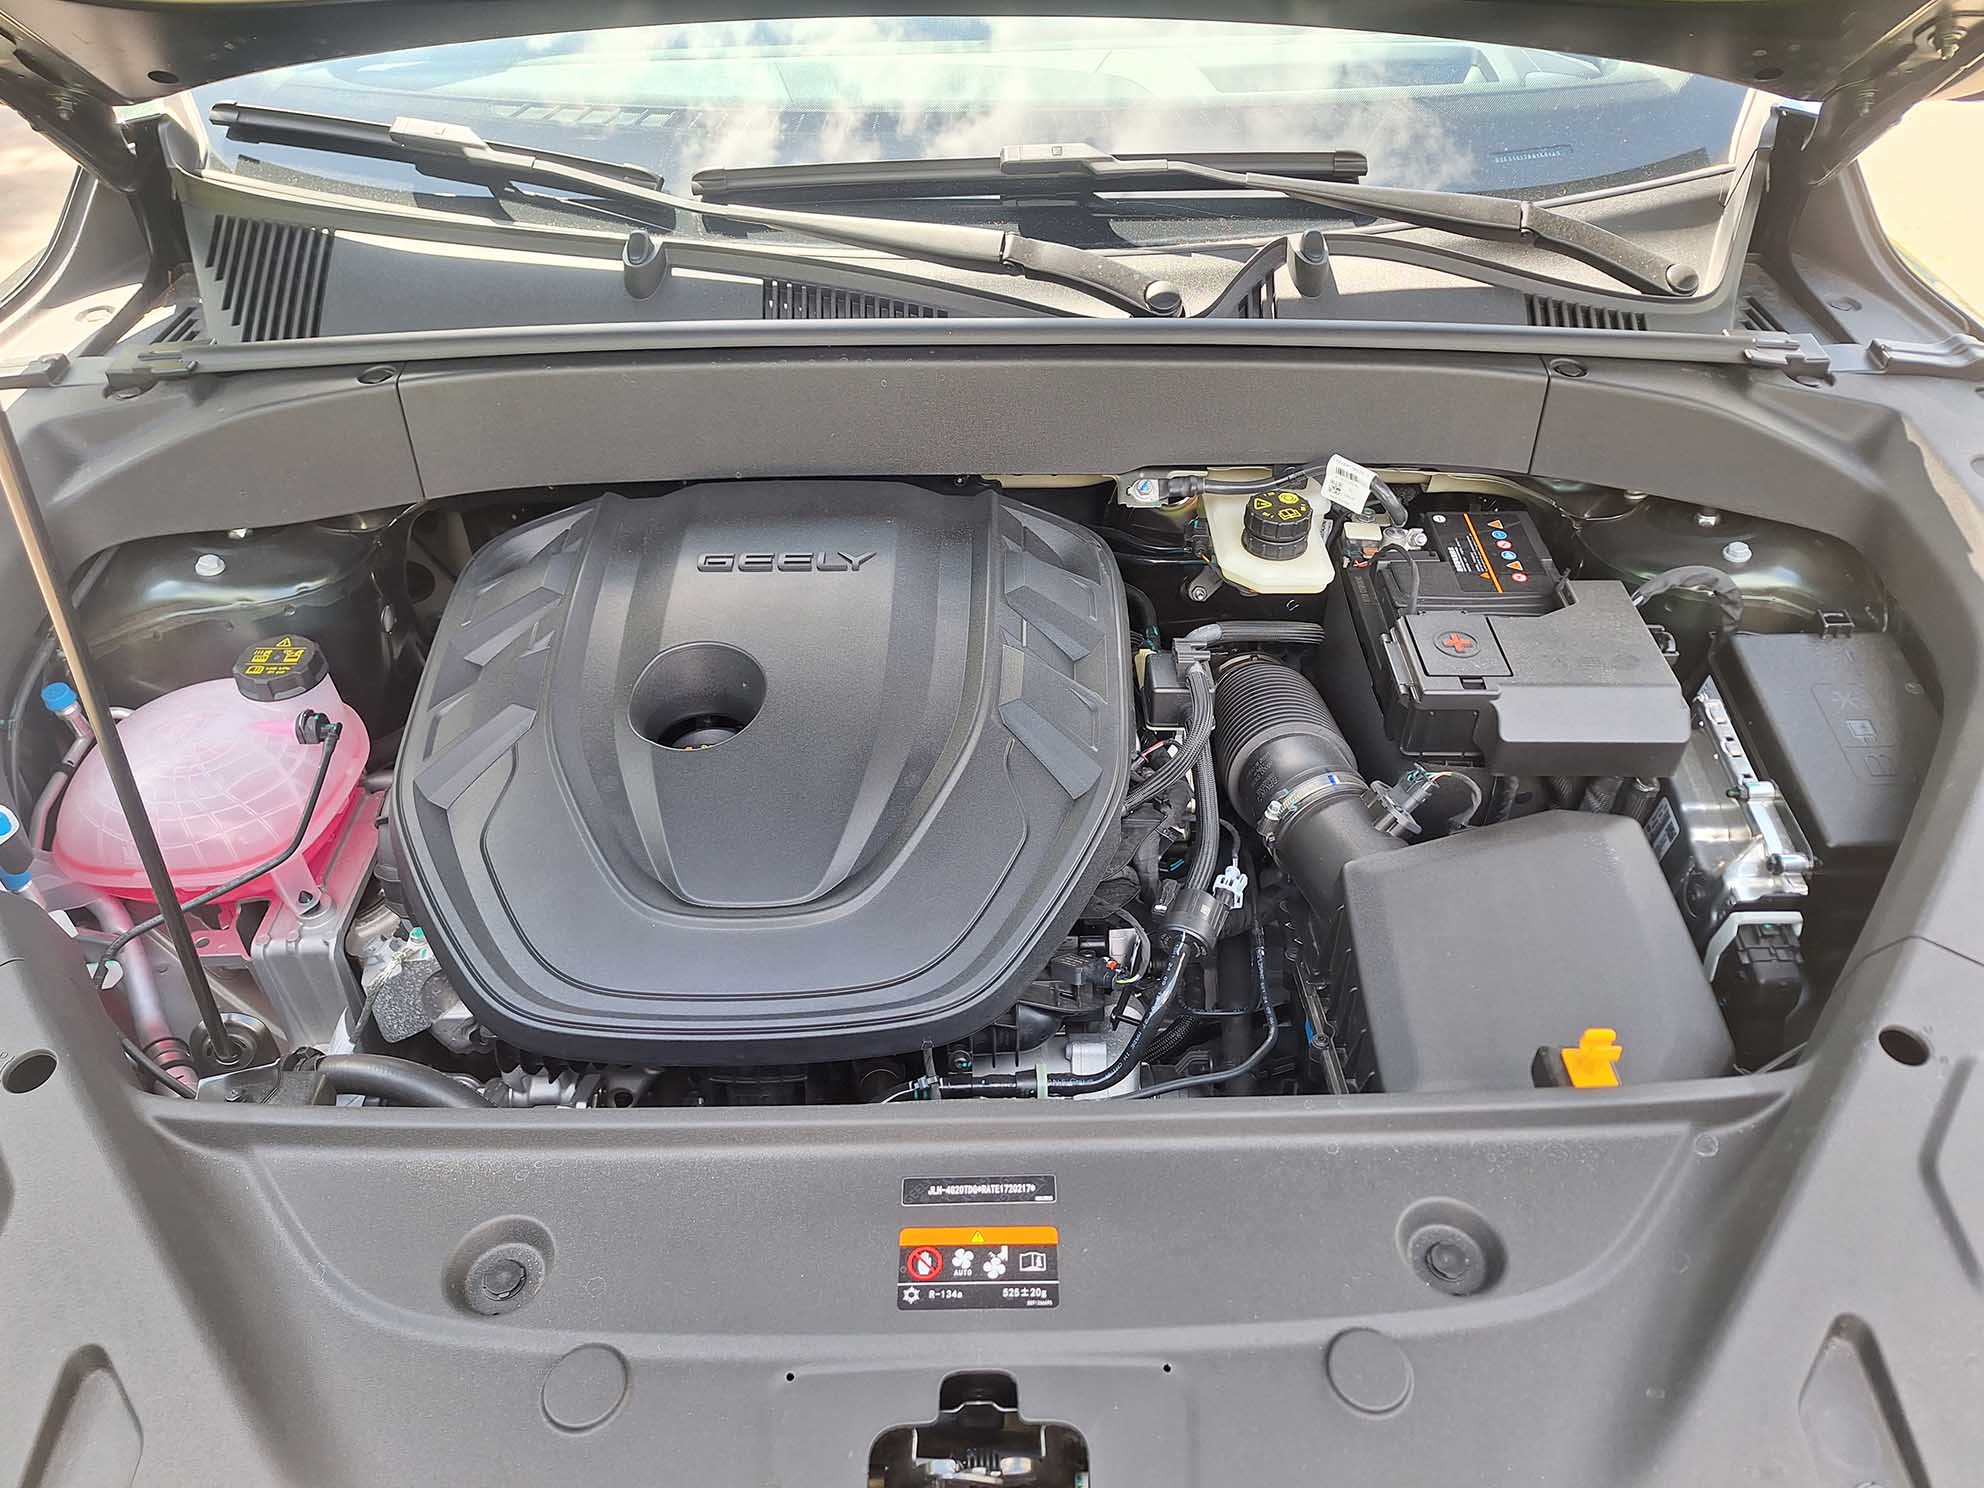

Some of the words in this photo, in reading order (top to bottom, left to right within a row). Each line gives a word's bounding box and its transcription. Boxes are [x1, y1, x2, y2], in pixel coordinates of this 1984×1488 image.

[697, 551, 877, 572] GEELY
[953, 1268, 972, 1276] AUTO
[928, 1289, 963, 1299] R-134a
